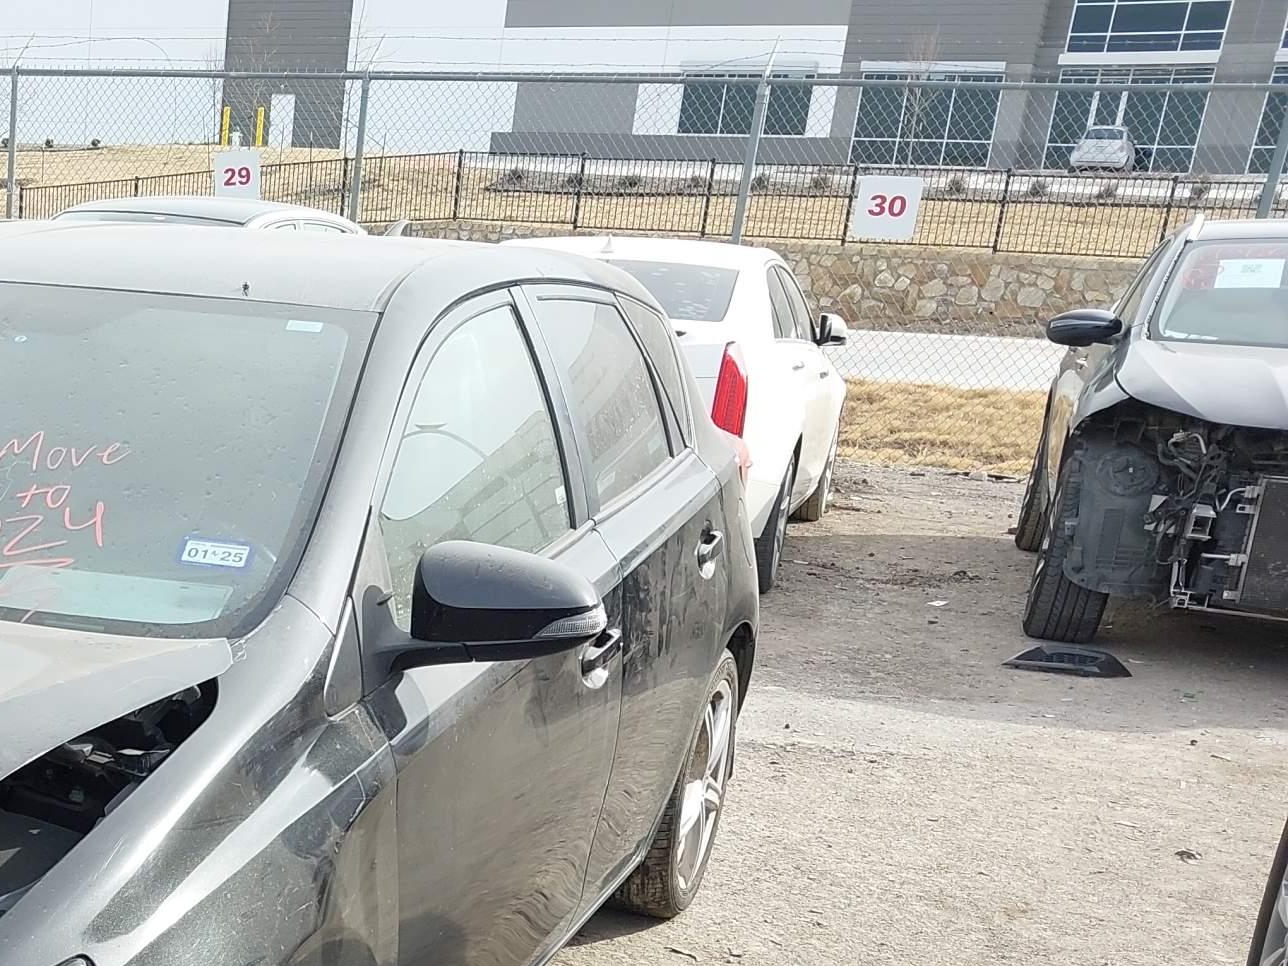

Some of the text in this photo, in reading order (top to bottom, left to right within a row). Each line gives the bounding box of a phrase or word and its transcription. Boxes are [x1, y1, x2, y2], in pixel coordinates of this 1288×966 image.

[223, 166, 251, 187] 29
[867, 194, 907, 217] 30
[15, 483, 72, 509] to
